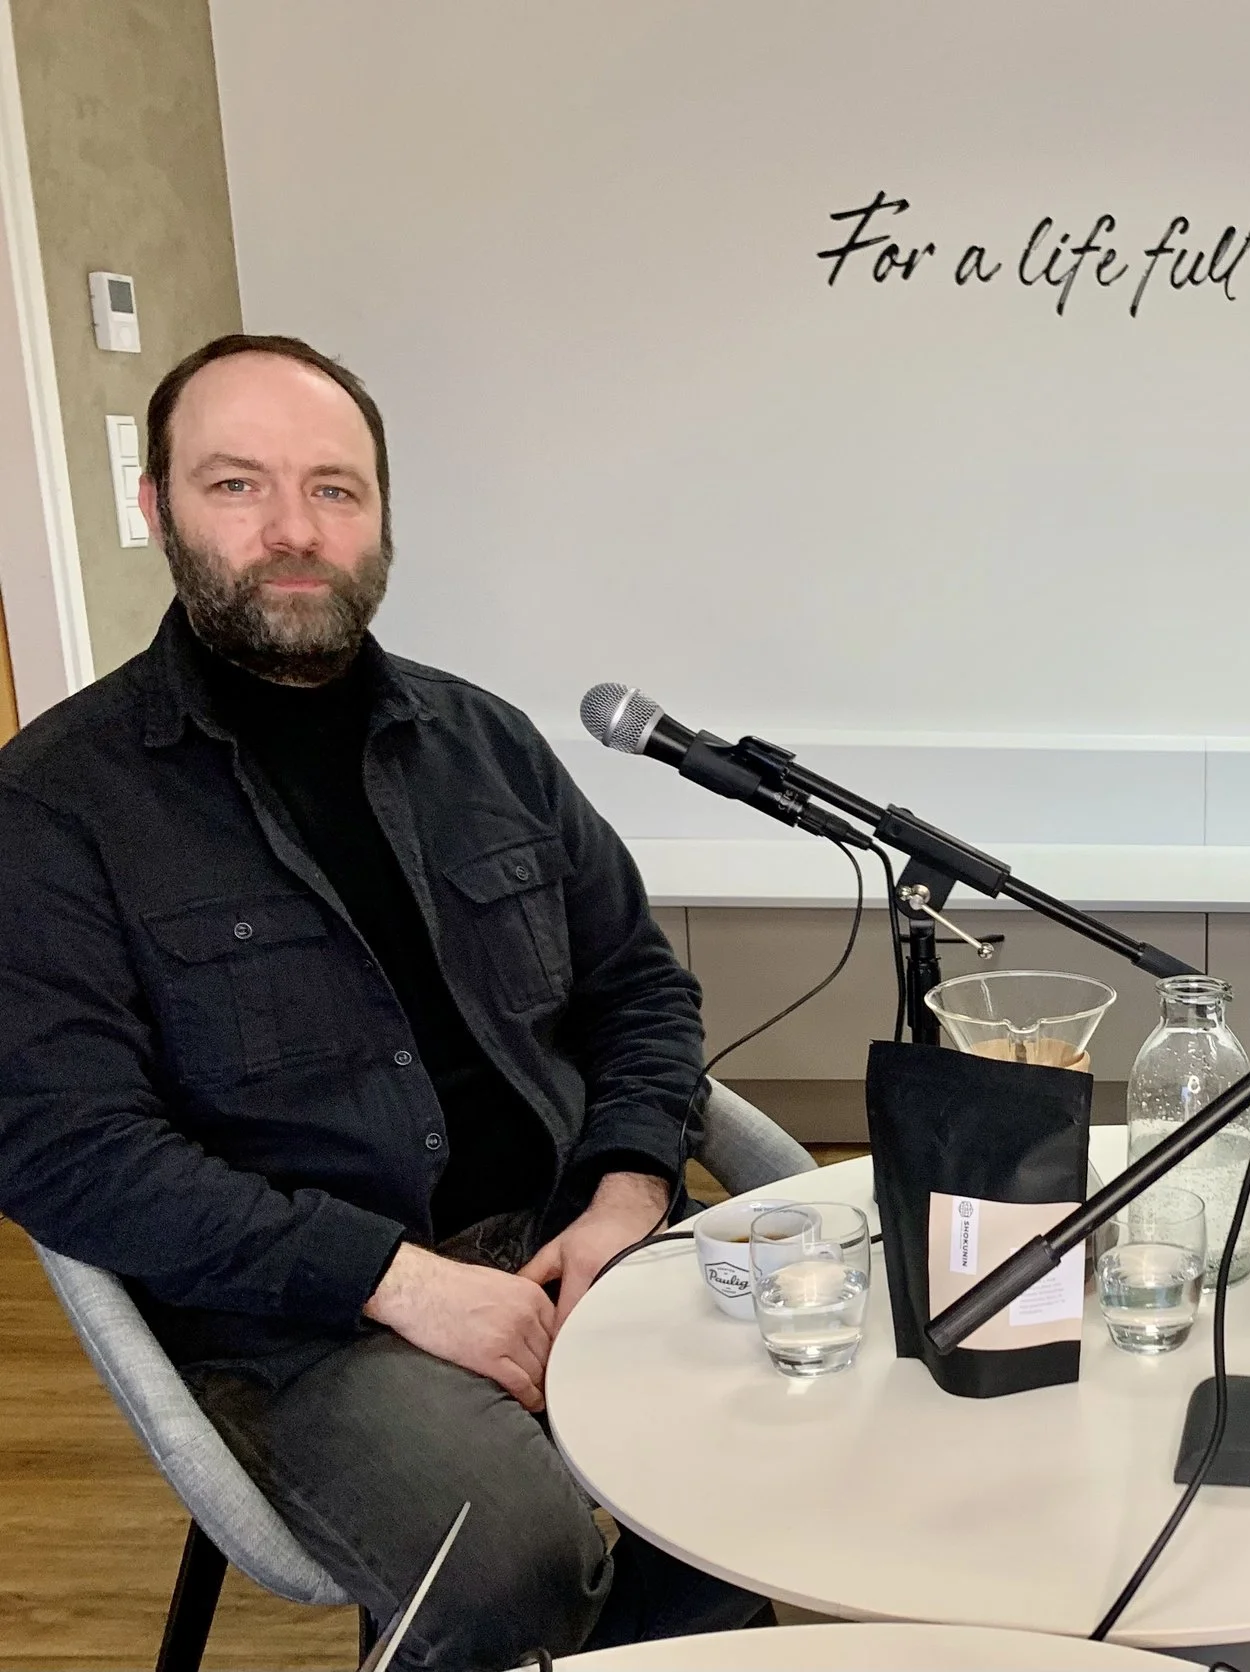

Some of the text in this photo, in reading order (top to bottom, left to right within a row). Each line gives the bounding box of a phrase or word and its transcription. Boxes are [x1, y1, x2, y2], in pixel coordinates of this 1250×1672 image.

[816, 190, 936, 286] For
[955, 245, 1002, 286] a
[1019, 214, 1130, 317] life
[962, 1220, 970, 1268] SHOKUNIN
[709, 1268, 749, 1290] Paulig
